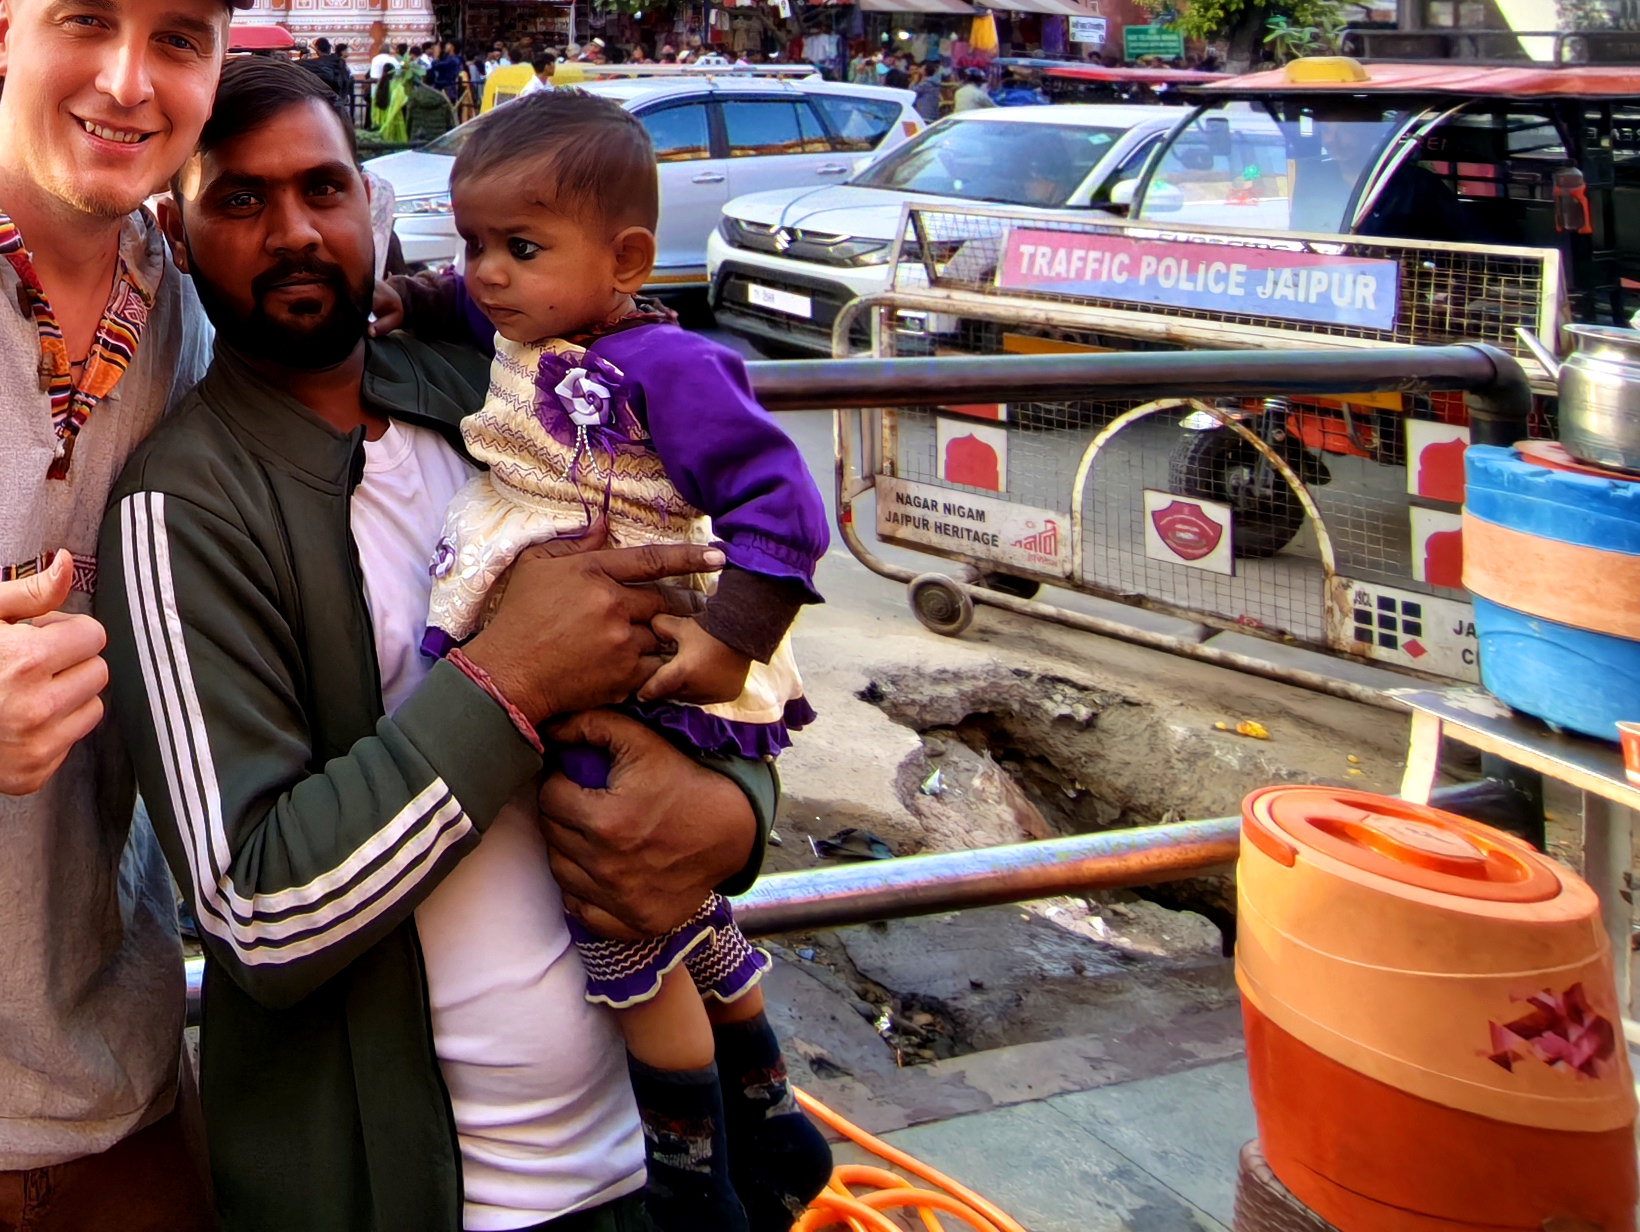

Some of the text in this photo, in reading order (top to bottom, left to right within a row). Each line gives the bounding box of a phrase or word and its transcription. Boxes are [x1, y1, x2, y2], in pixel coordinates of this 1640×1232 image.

[1019, 244, 1377, 311] TRAFFIC POLICE JAIPUR
[896, 491, 986, 523] NAGAR NIGAM
[885, 510, 930, 531] JAIPUR
[934, 521, 999, 548] HERITAGE
[1452, 619, 1478, 639] JA
